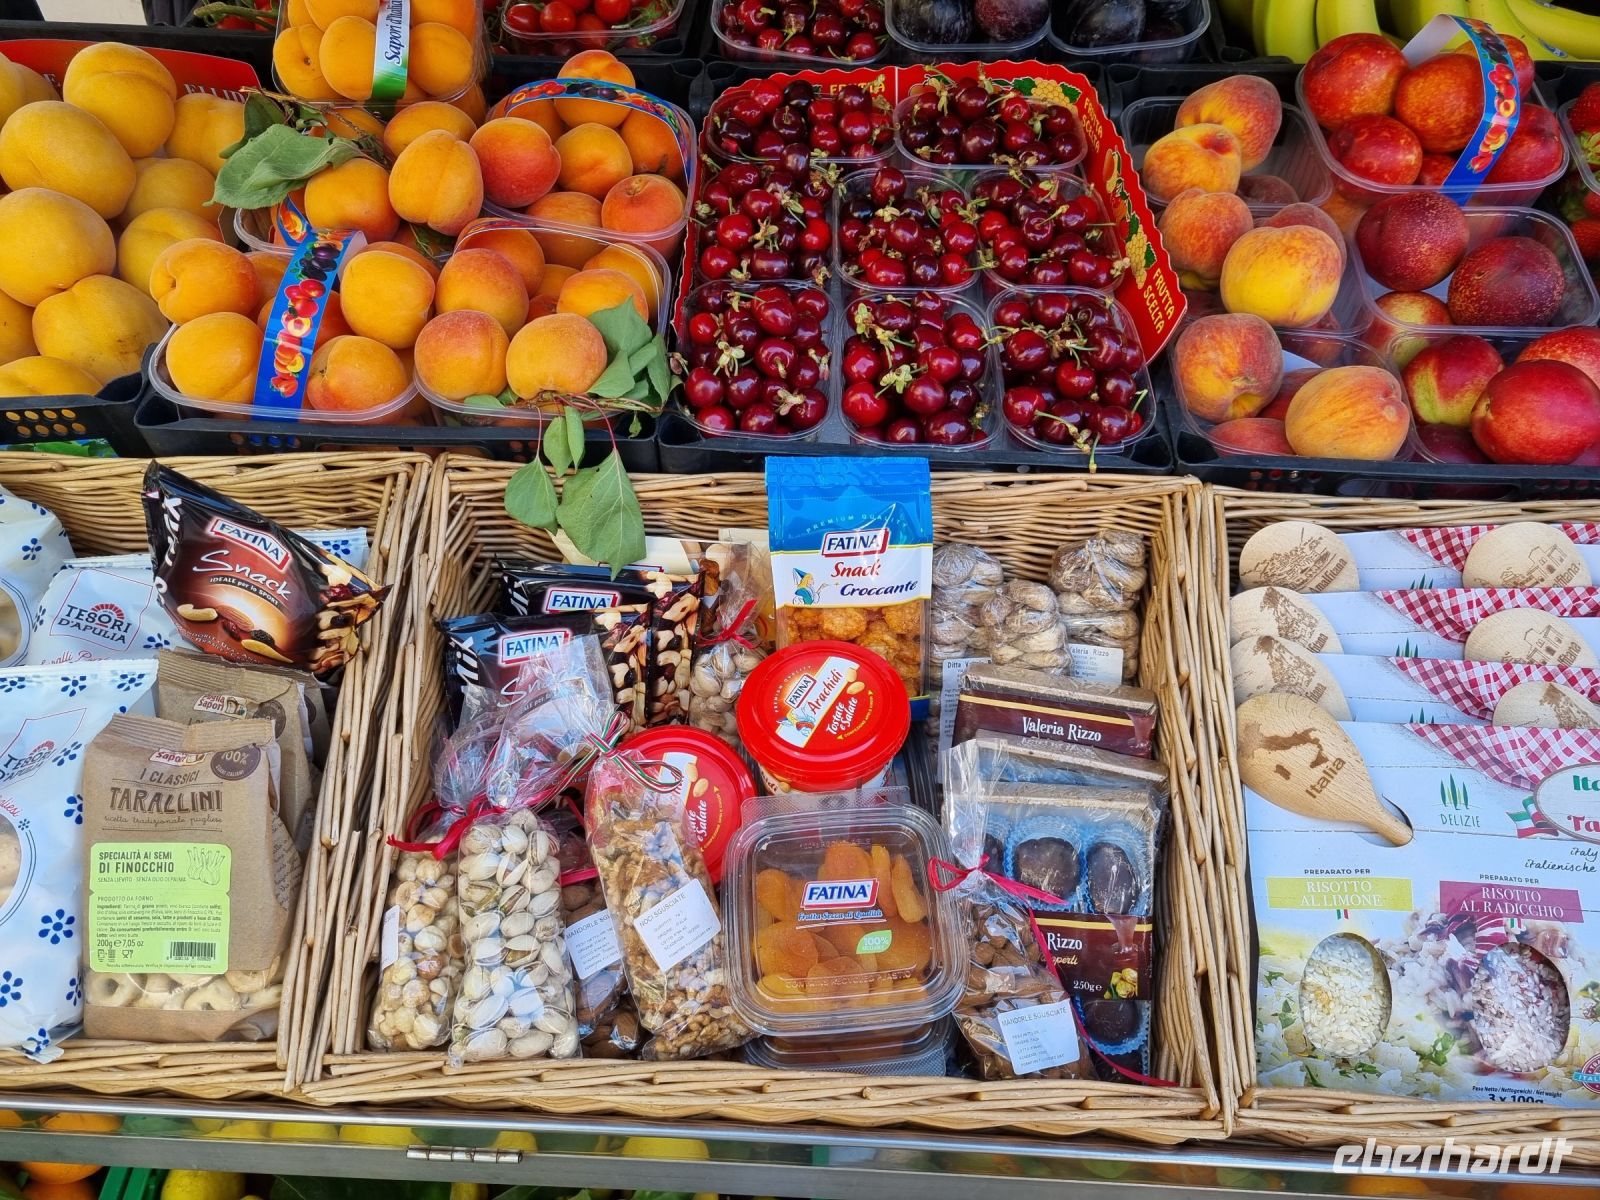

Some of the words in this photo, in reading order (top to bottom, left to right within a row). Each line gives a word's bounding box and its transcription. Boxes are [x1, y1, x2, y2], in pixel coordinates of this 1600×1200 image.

[384, 25, 404, 65] Sapori
[1084, 97, 1103, 139] FRUTTA
[1153, 268, 1175, 320] FRUTTA
[1143, 285, 1165, 334] SCELTA
[806, 515, 854, 533] PREMIUM
[861, 513, 908, 528] QUALITY
[219, 523, 280, 560] FATINA
[827, 535, 880, 551] FATINA
[192, 549, 292, 601] Snack
[831, 559, 881, 578] Snack
[237, 580, 249, 589] per
[258, 589, 279, 606] SPORT
[840, 580, 919, 597] Croccante
[551, 595, 607, 609] FATINA
[65, 604, 132, 633] TESORI
[57, 618, 127, 644] D'APULIA
[506, 635, 560, 656] FATINA
[947, 661, 962, 669] Ditta
[788, 678, 812, 705] FATINA
[807, 668, 843, 715] Arachidi
[198, 700, 224, 711] Sapori
[840, 697, 858, 728] Salate
[826, 701, 845, 735] Tostate
[840, 723, 846, 731] e
[1022, 716, 1064, 736] Valeria
[1067, 723, 1102, 742] Rizzo
[149, 769, 200, 786] CLASSICI
[1305, 755, 1347, 799] Italia
[109, 786, 223, 815] TARALLINI
[103, 815, 129, 823] ricetta
[132, 815, 186, 827] tradizionale
[189, 814, 223, 827] pugliese
[694, 800, 708, 836] Salate
[1440, 813, 1481, 828] DELIZIE
[99, 849, 141, 860] SPECIALITÀ
[143, 851, 151, 860] AI
[154, 851, 172, 860] SEMI
[1570, 847, 1598, 862] italy
[99, 862, 110, 873] DI
[115, 861, 175, 873] FINOCCHIO
[1525, 858, 1597, 873] italienische
[1306, 880, 1372, 893] RISOTTO
[1479, 874, 1523, 883] PREPARATO
[807, 884, 868, 901] FATINA
[1300, 895, 1318, 906] AL
[1322, 894, 1383, 907] LIMONE
[1481, 887, 1541, 903] RISOTTO
[639, 913, 654, 928] NOCI
[653, 892, 686, 918] SGUSCIATE
[1460, 900, 1479, 913] AL
[1483, 901, 1564, 918] RADICCHIO
[97, 940, 113, 948] 200g
[863, 935, 889, 946] 100%
[1046, 932, 1083, 951] Rizzo
[1073, 980, 1095, 993] 250g
[1001, 1015, 1033, 1026] MANDORLE
[1033, 1006, 1068, 1020] SGUSCIATE
[1500, 1087, 1533, 1095] Nettogewicht
